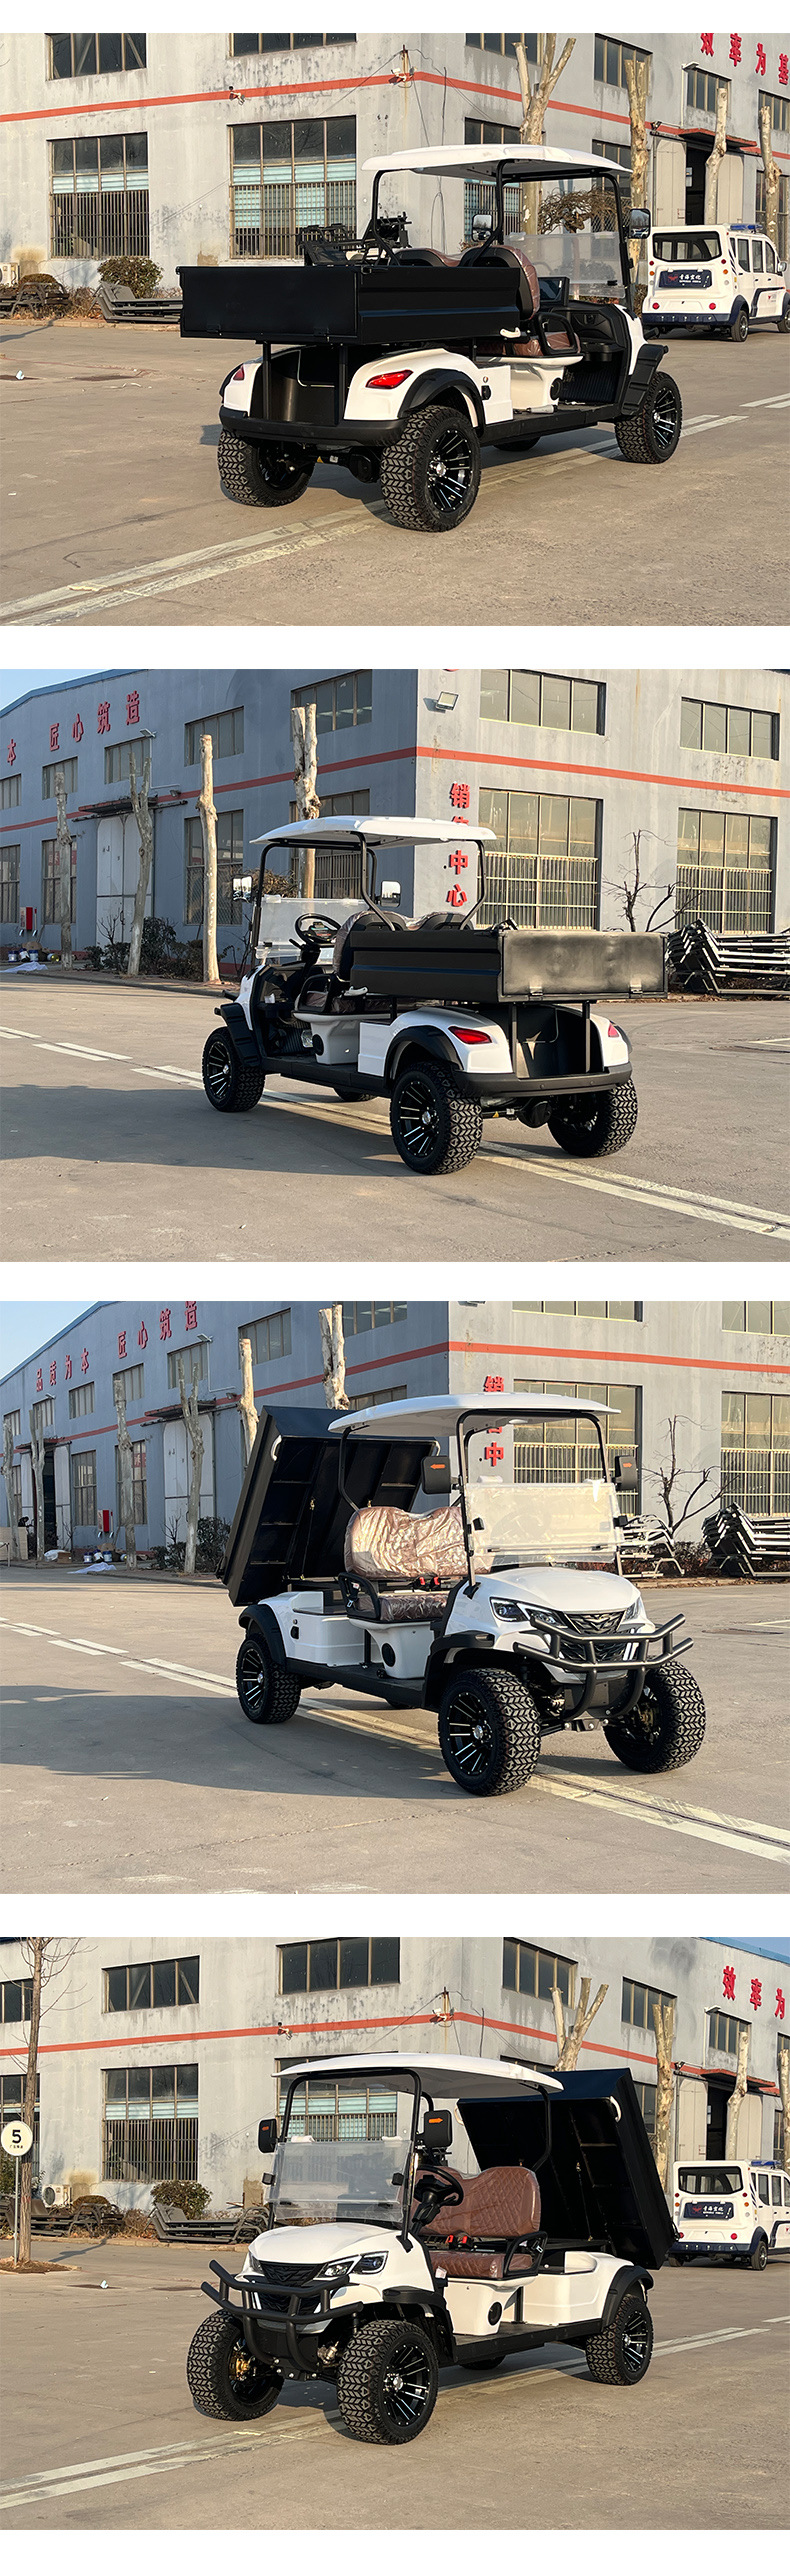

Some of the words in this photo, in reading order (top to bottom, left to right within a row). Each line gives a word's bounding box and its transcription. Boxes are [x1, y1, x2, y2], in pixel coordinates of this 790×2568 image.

[49, 690, 140, 752] 匠心筑造
[36, 1347, 90, 1392] 品质为本
[483, 1375, 504, 1467] 销中
[722, 1965, 785, 2020] 效率为
[12, 2129, 21, 2144] 5
